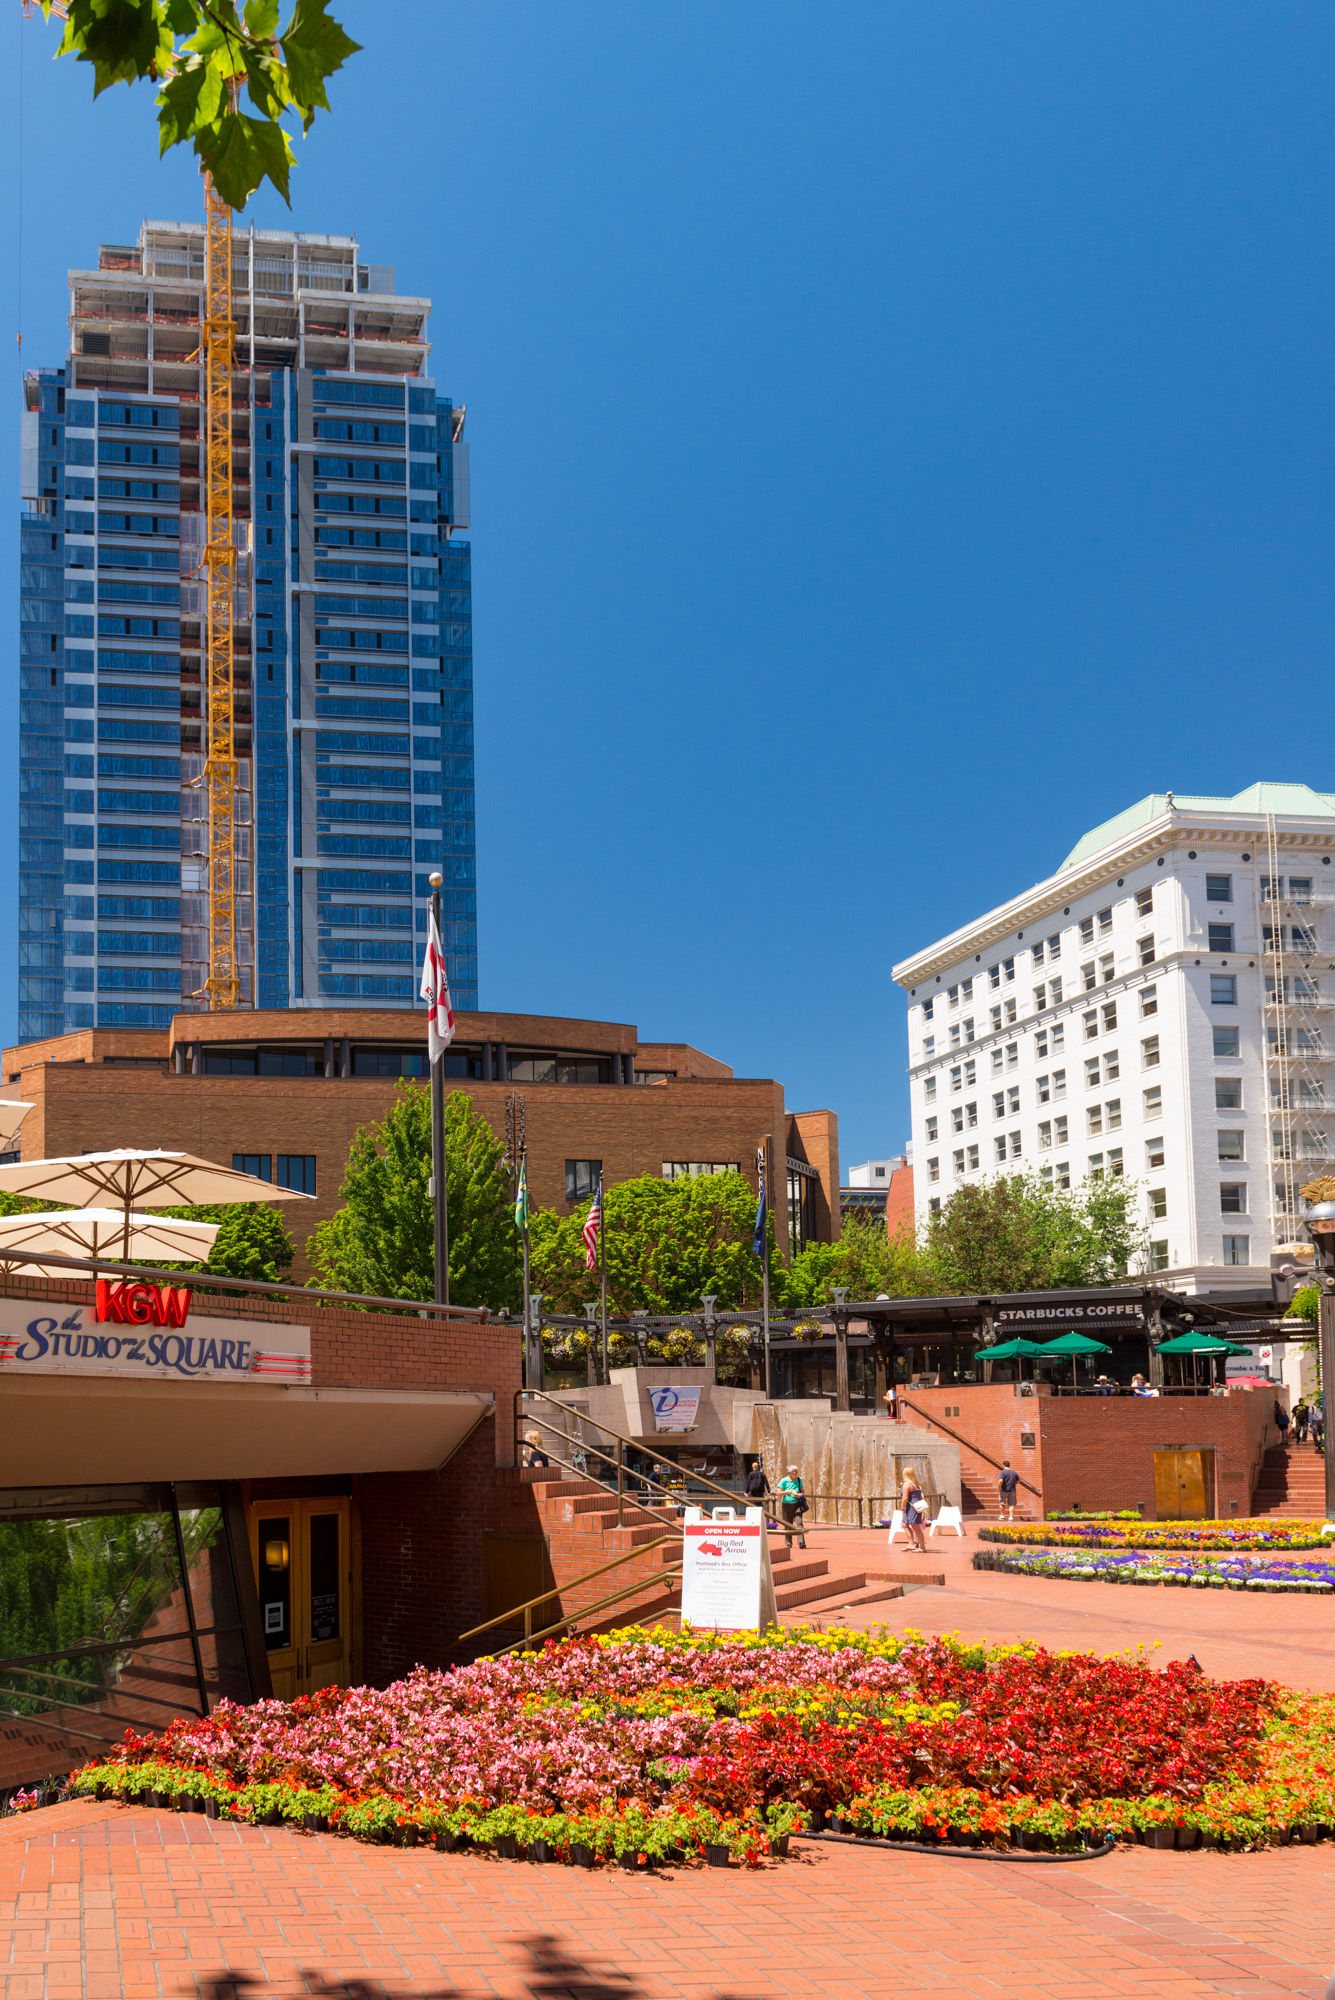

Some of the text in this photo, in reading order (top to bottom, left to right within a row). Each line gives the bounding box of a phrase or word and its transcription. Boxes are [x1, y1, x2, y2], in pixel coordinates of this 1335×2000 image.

[96, 1279, 193, 1328] KGW
[998, 1304, 1143, 1320] STARBUCKS COFFEE
[61, 1308, 84, 1331] the
[15, 1317, 122, 1361] STUDIO
[126, 1339, 147, 1360] the
[145, 1334, 251, 1376] SQUARE
[717, 1540, 728, 1548] Big
[724, 1546, 747, 1554] Arrow
